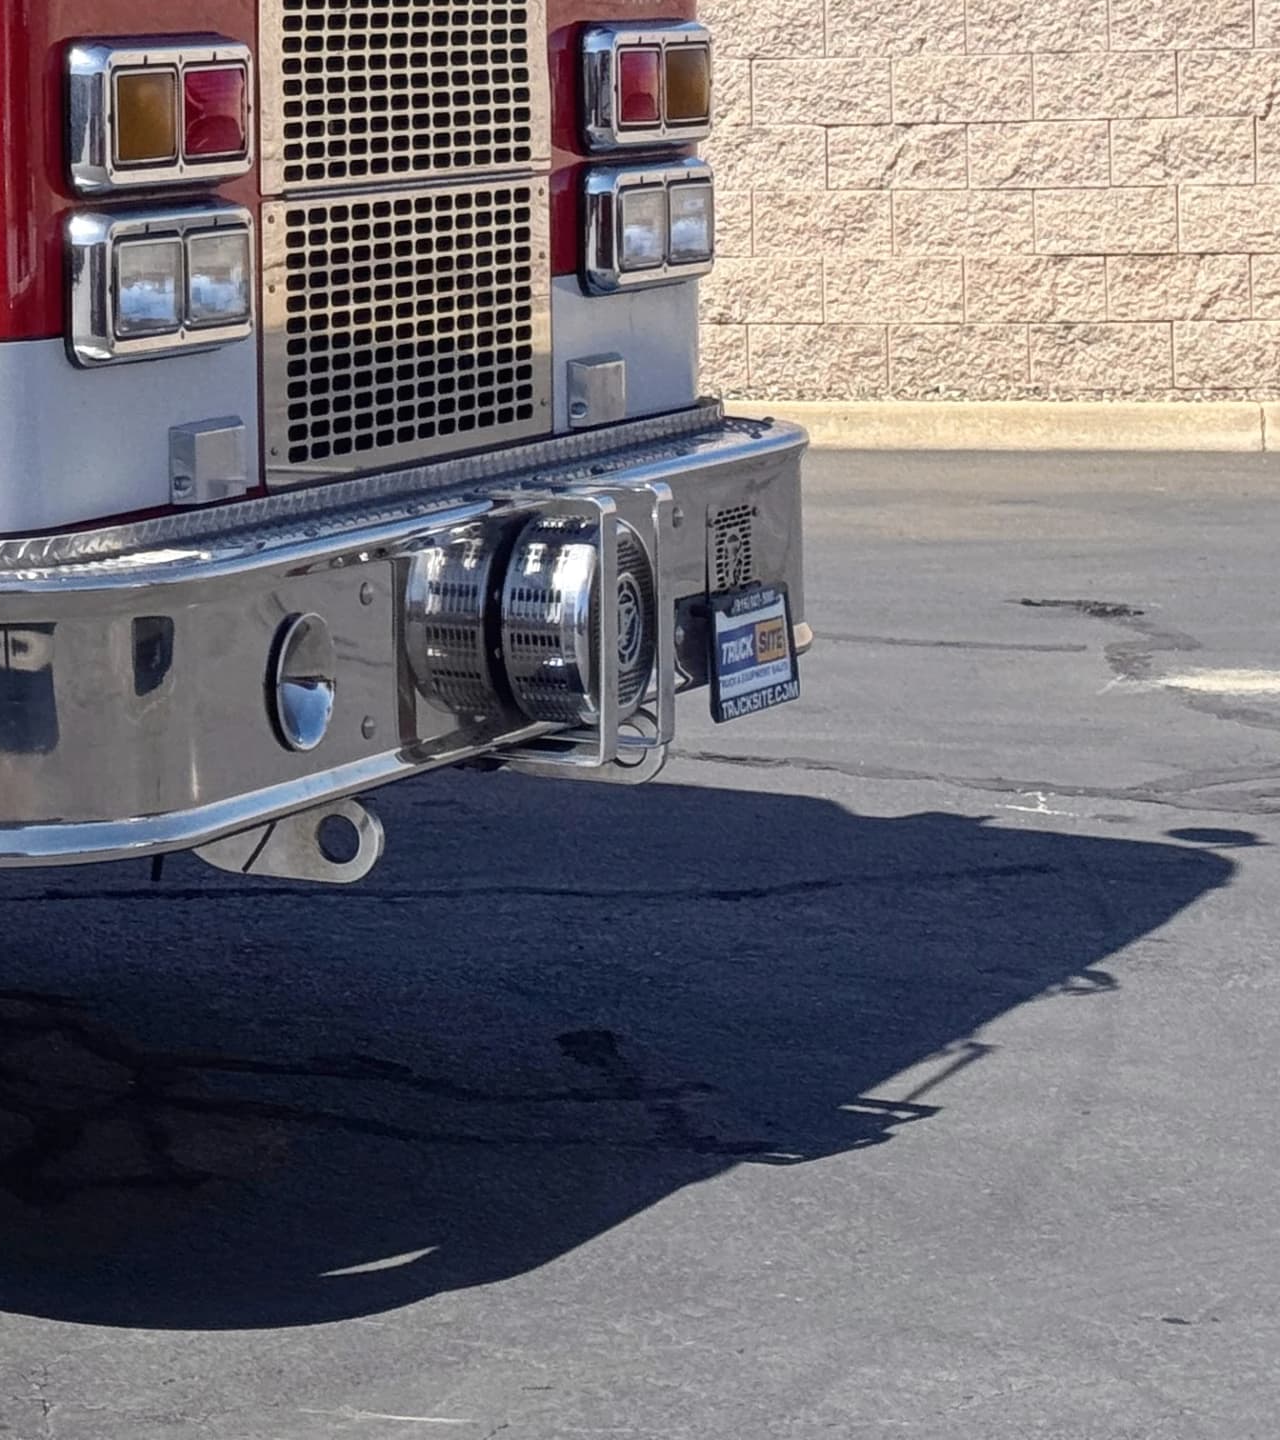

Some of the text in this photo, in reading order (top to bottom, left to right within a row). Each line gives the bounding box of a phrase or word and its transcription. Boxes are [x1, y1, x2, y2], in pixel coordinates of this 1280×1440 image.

[722, 627, 784, 665] TRUCK SITE
[721, 680, 798, 720] TRUCKSITE.COM
